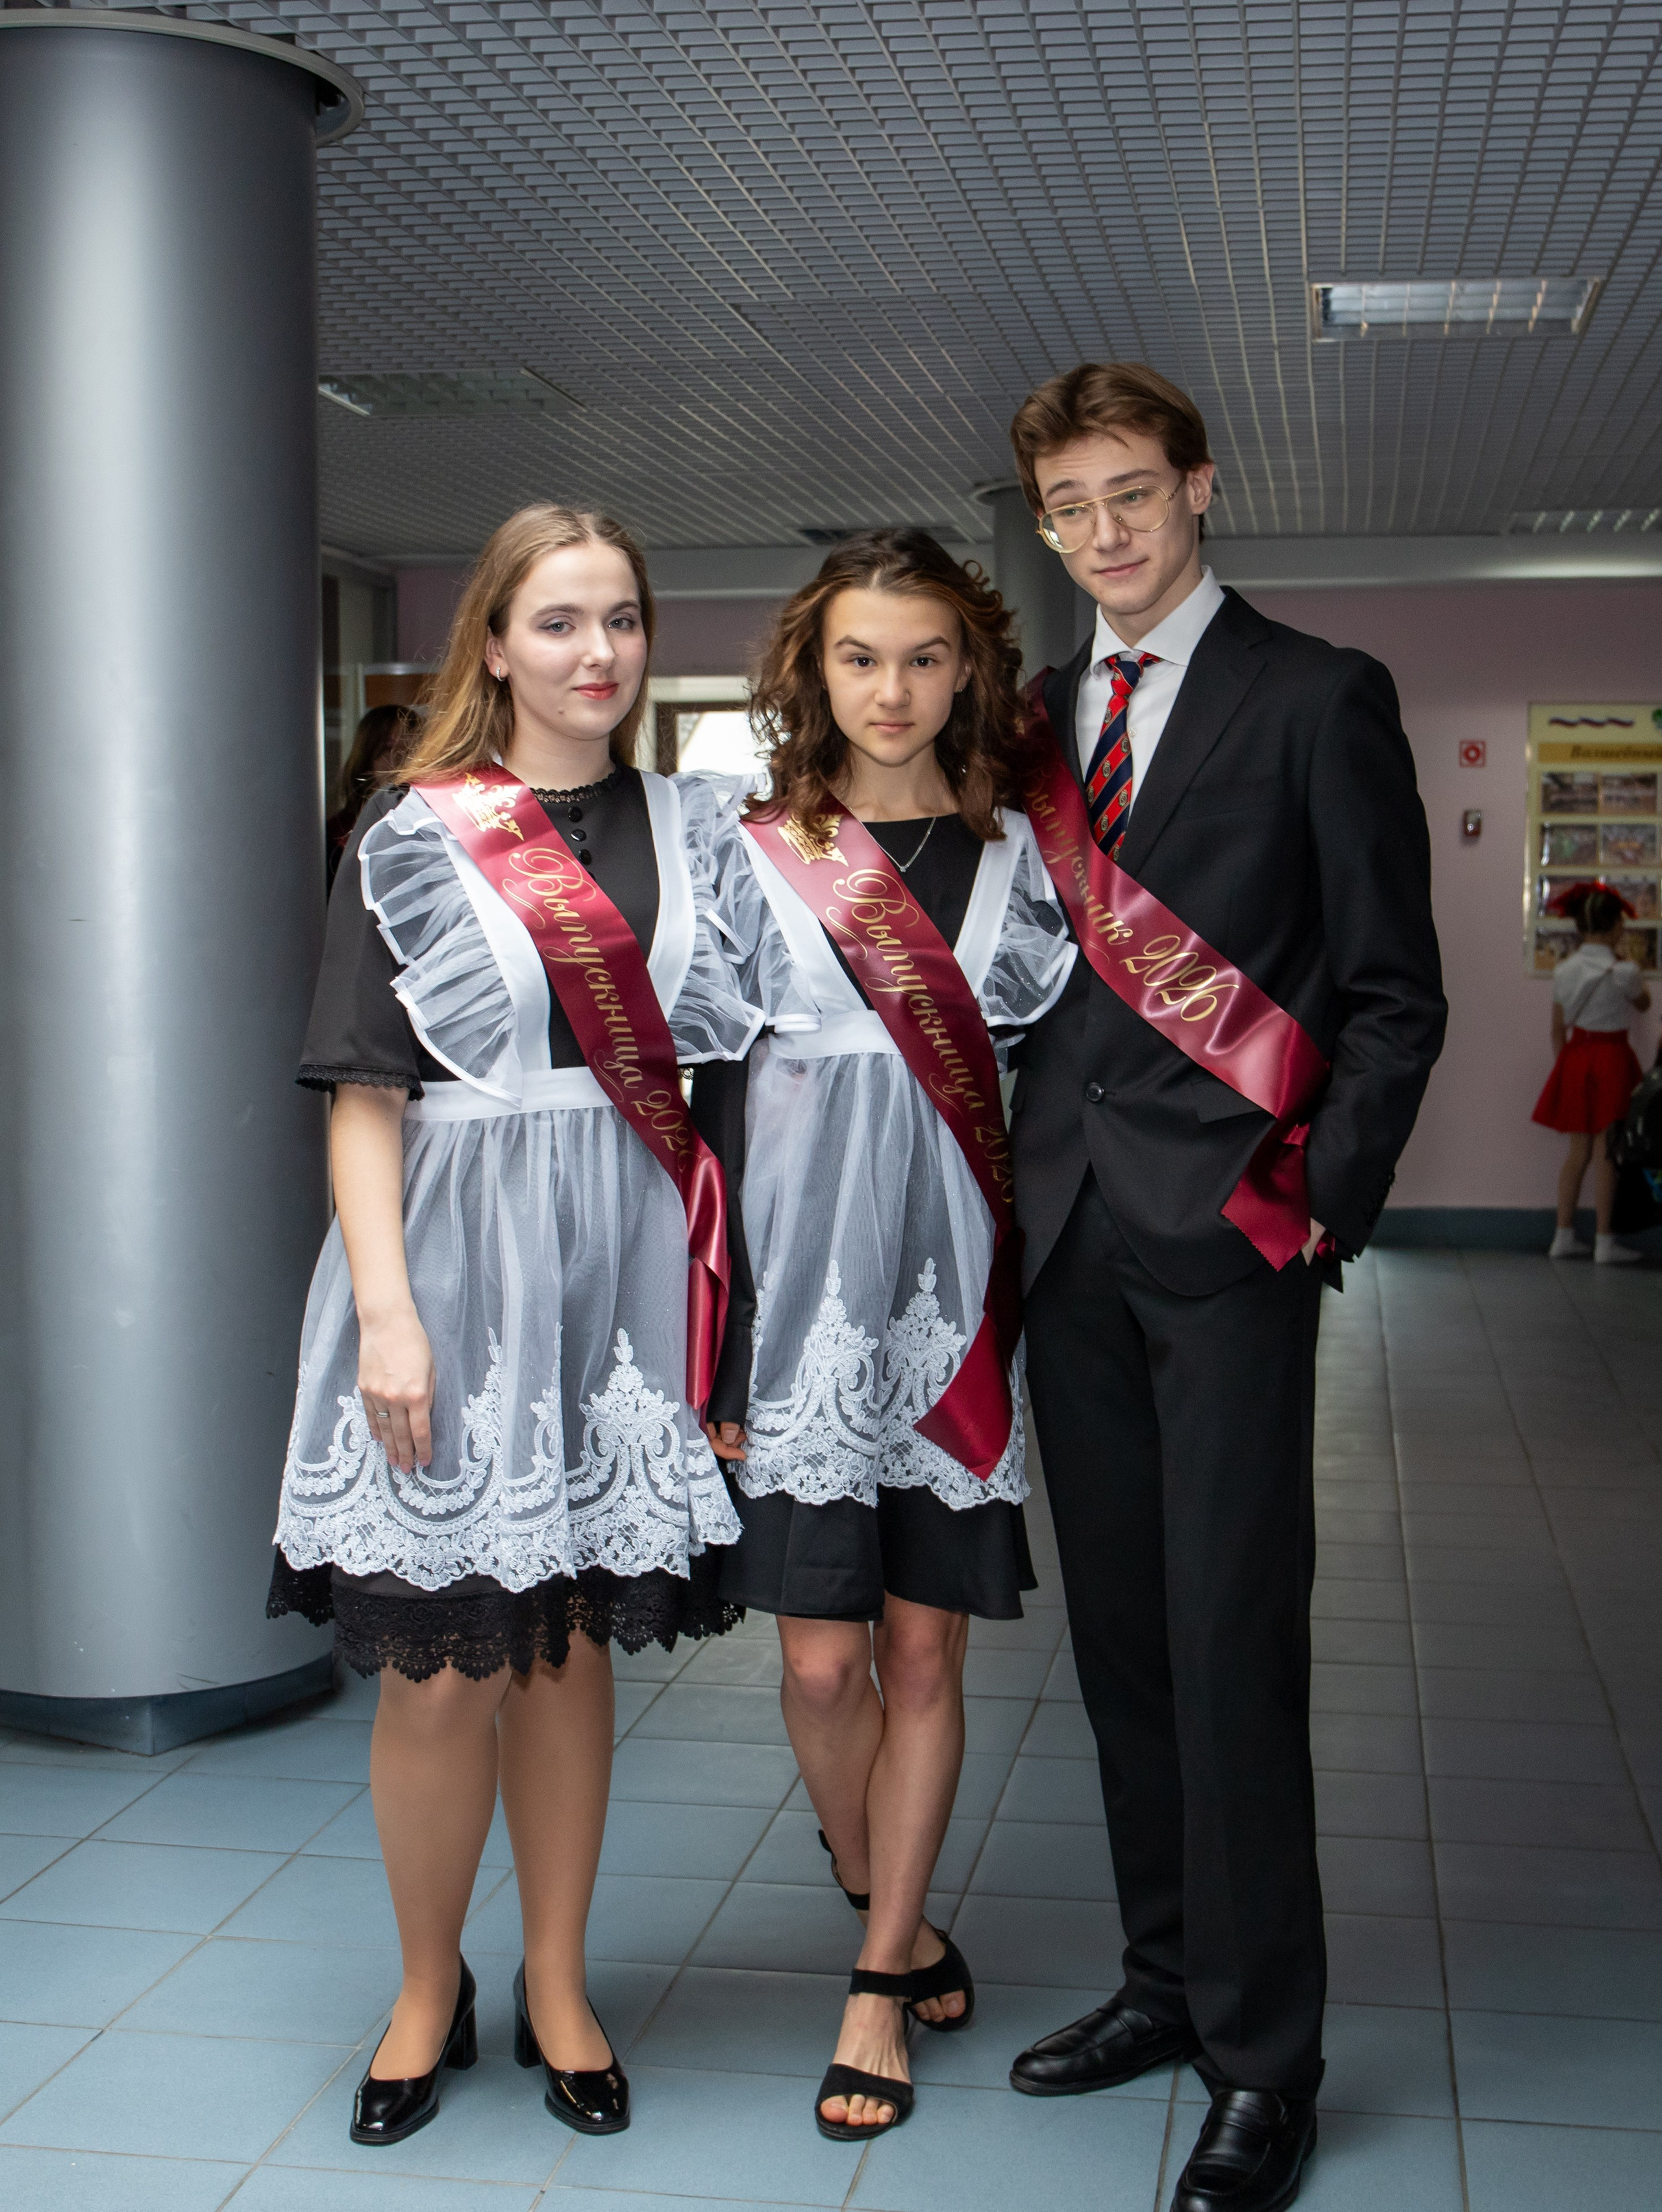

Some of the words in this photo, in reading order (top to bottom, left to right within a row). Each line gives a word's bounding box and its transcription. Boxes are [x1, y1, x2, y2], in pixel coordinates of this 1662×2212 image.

[502, 847, 644, 1103] Выпускница
[826, 869, 986, 1115] Выпускница
[1024, 779, 1134, 963] ыпускник
[1119, 934, 1239, 1022] 2026
